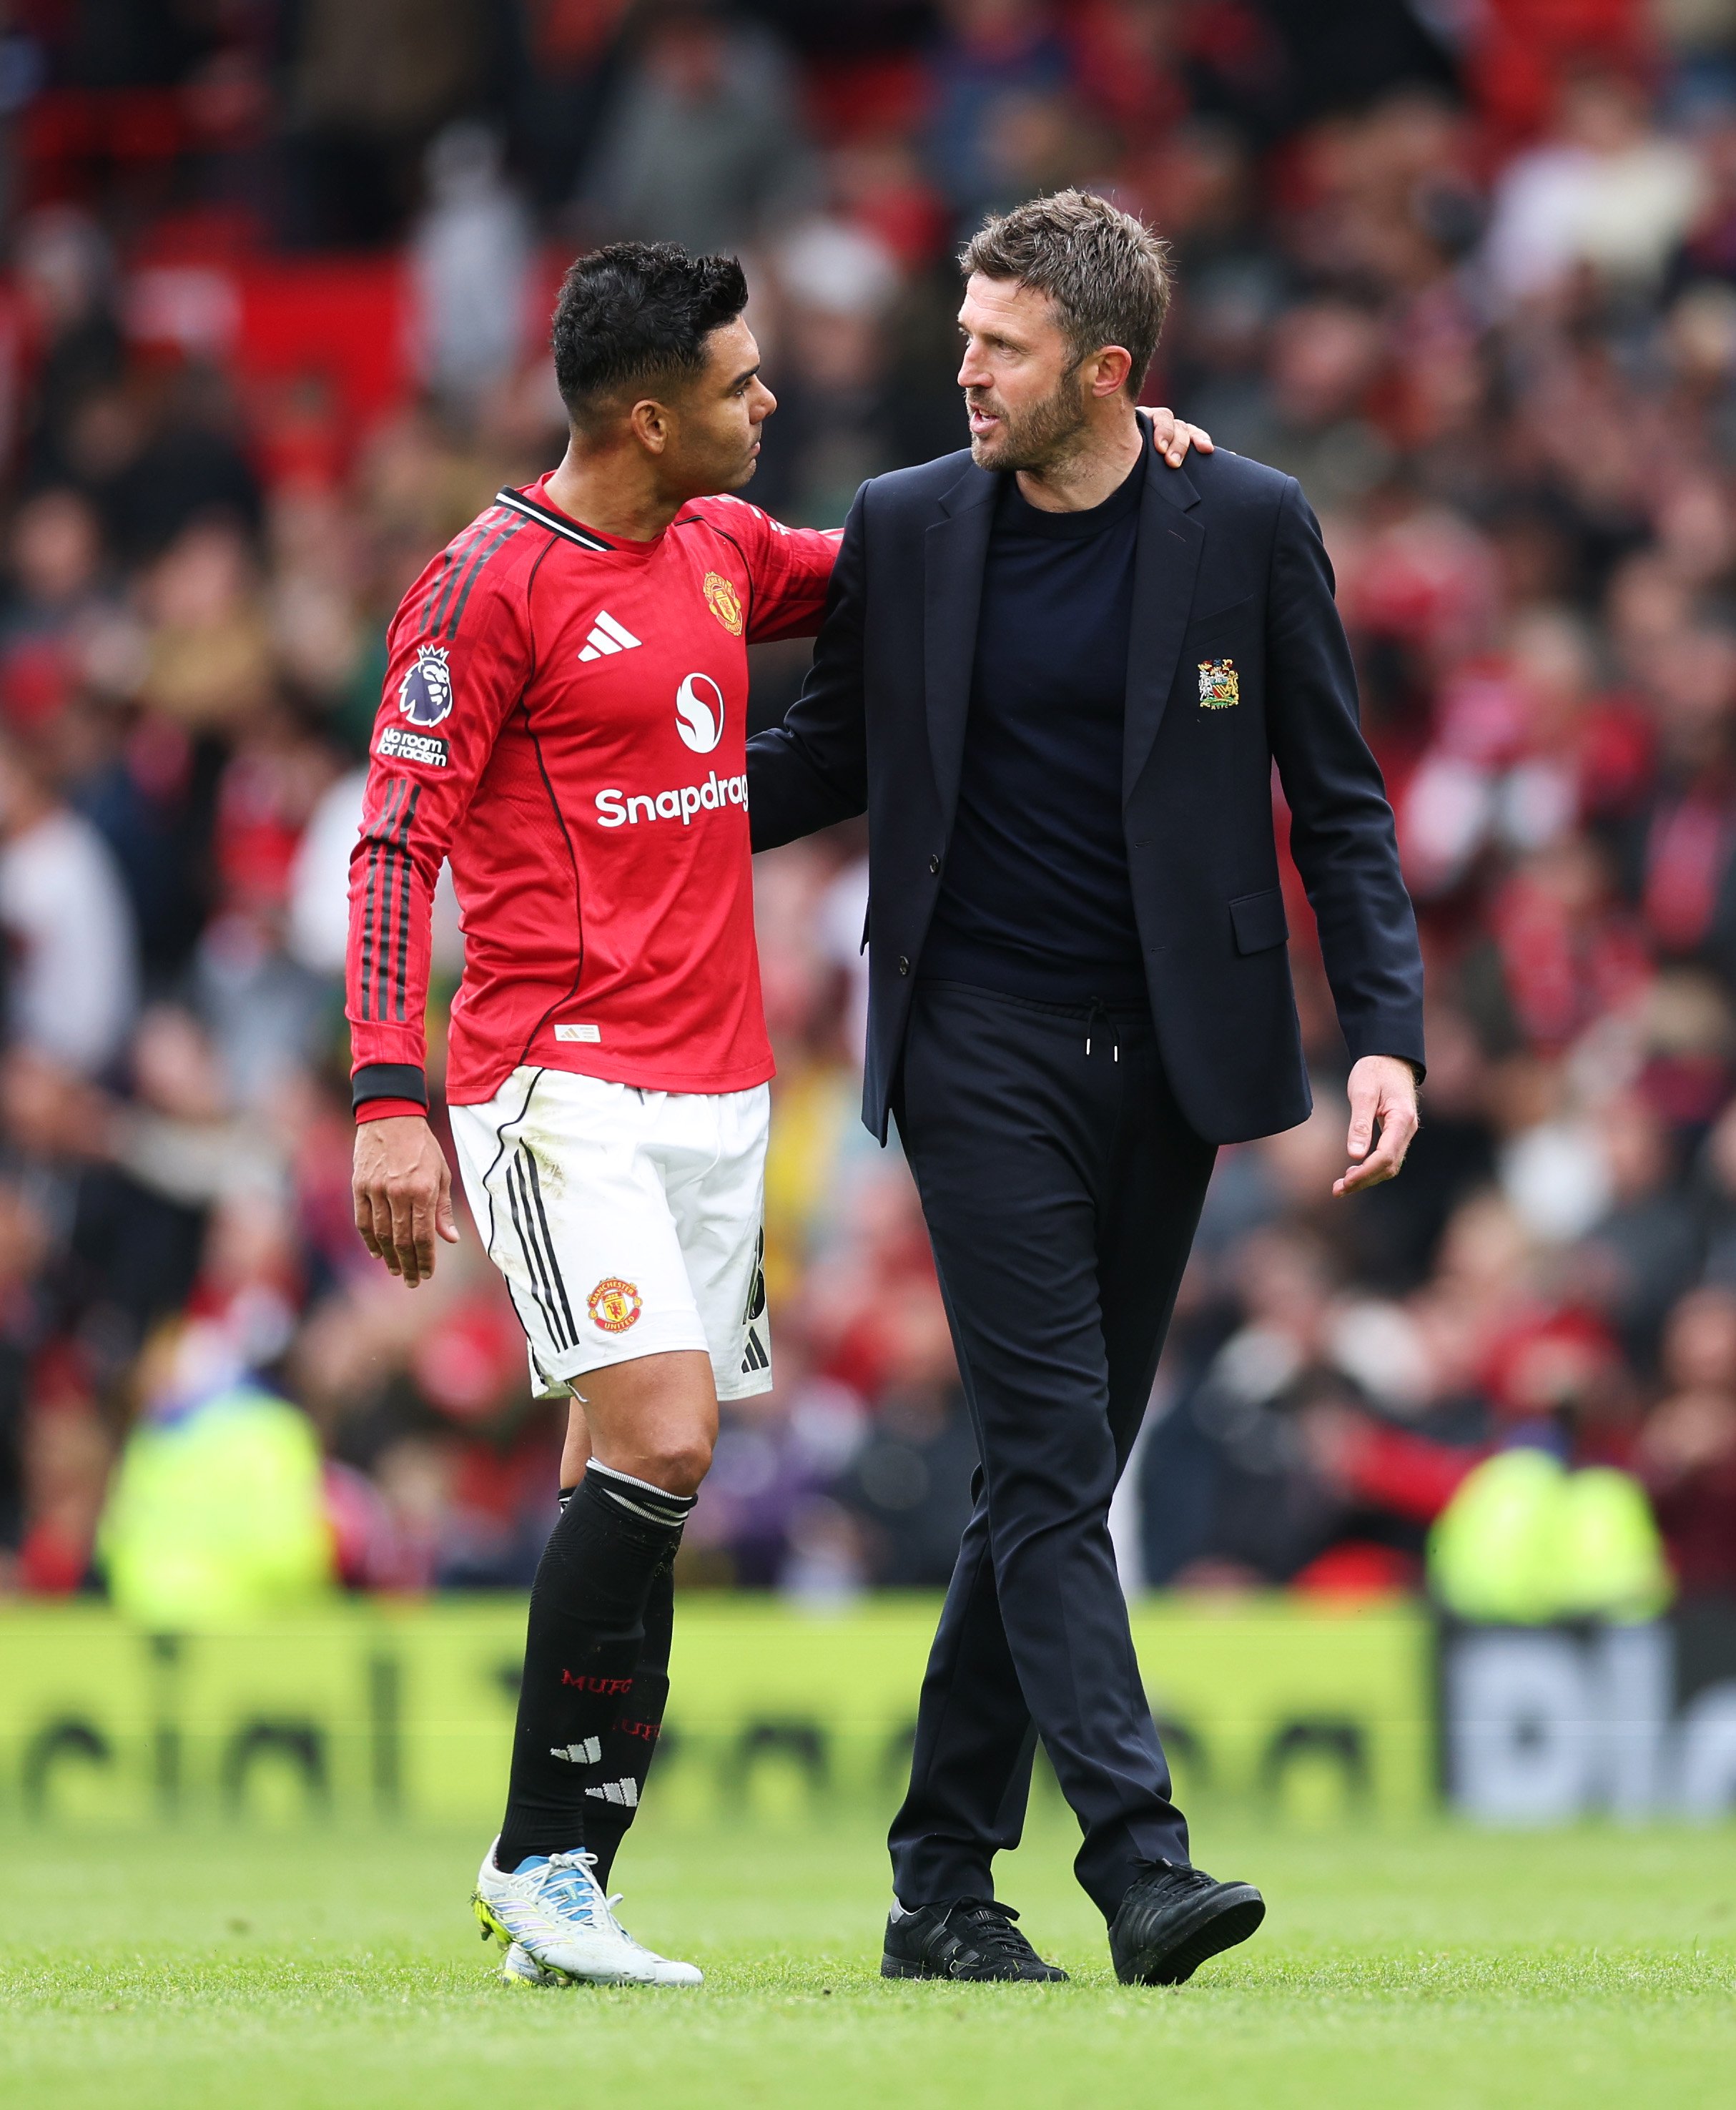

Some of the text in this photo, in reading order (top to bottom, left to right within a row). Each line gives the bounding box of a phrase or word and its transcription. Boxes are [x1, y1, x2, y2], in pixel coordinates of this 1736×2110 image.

[383, 727, 443, 754] No room
[377, 741, 447, 767] for racism
[595, 770, 749, 828] Snapdrag
[591, 1281, 635, 1305] MANCHESTER
[604, 1316, 635, 1330] UNITED
